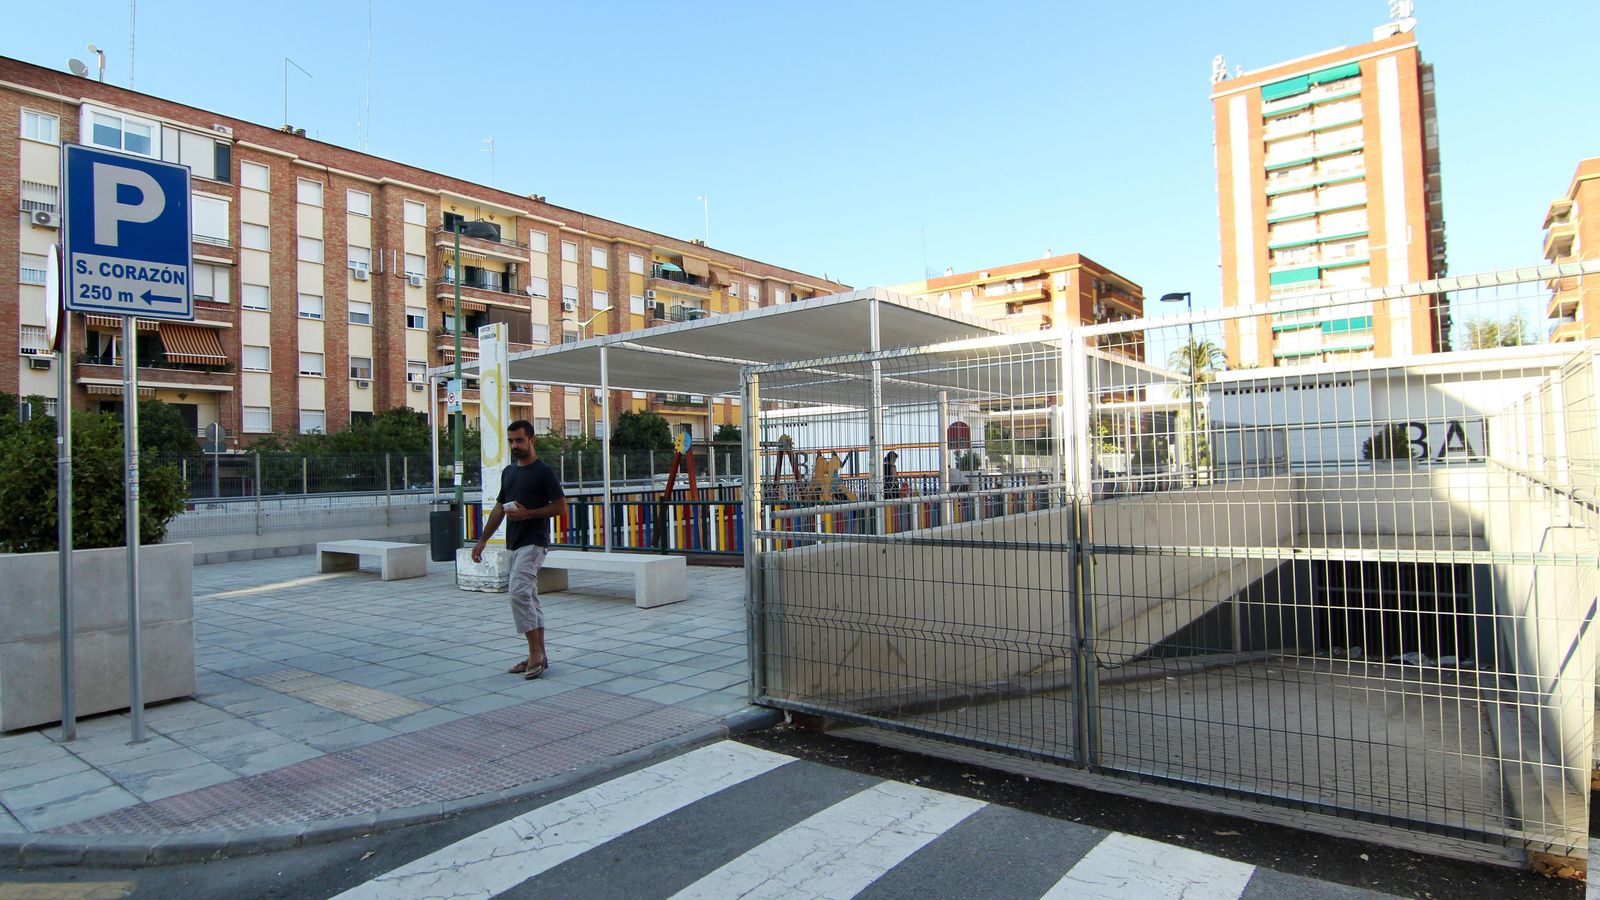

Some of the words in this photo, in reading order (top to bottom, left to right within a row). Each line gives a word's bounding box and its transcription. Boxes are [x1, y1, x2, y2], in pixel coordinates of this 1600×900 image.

[93, 161, 166, 247] P
[76, 259, 93, 275] S.
[99, 261, 185, 286] CORAZÓN
[79, 283, 112, 301] 250
[118, 291, 134, 303] m
